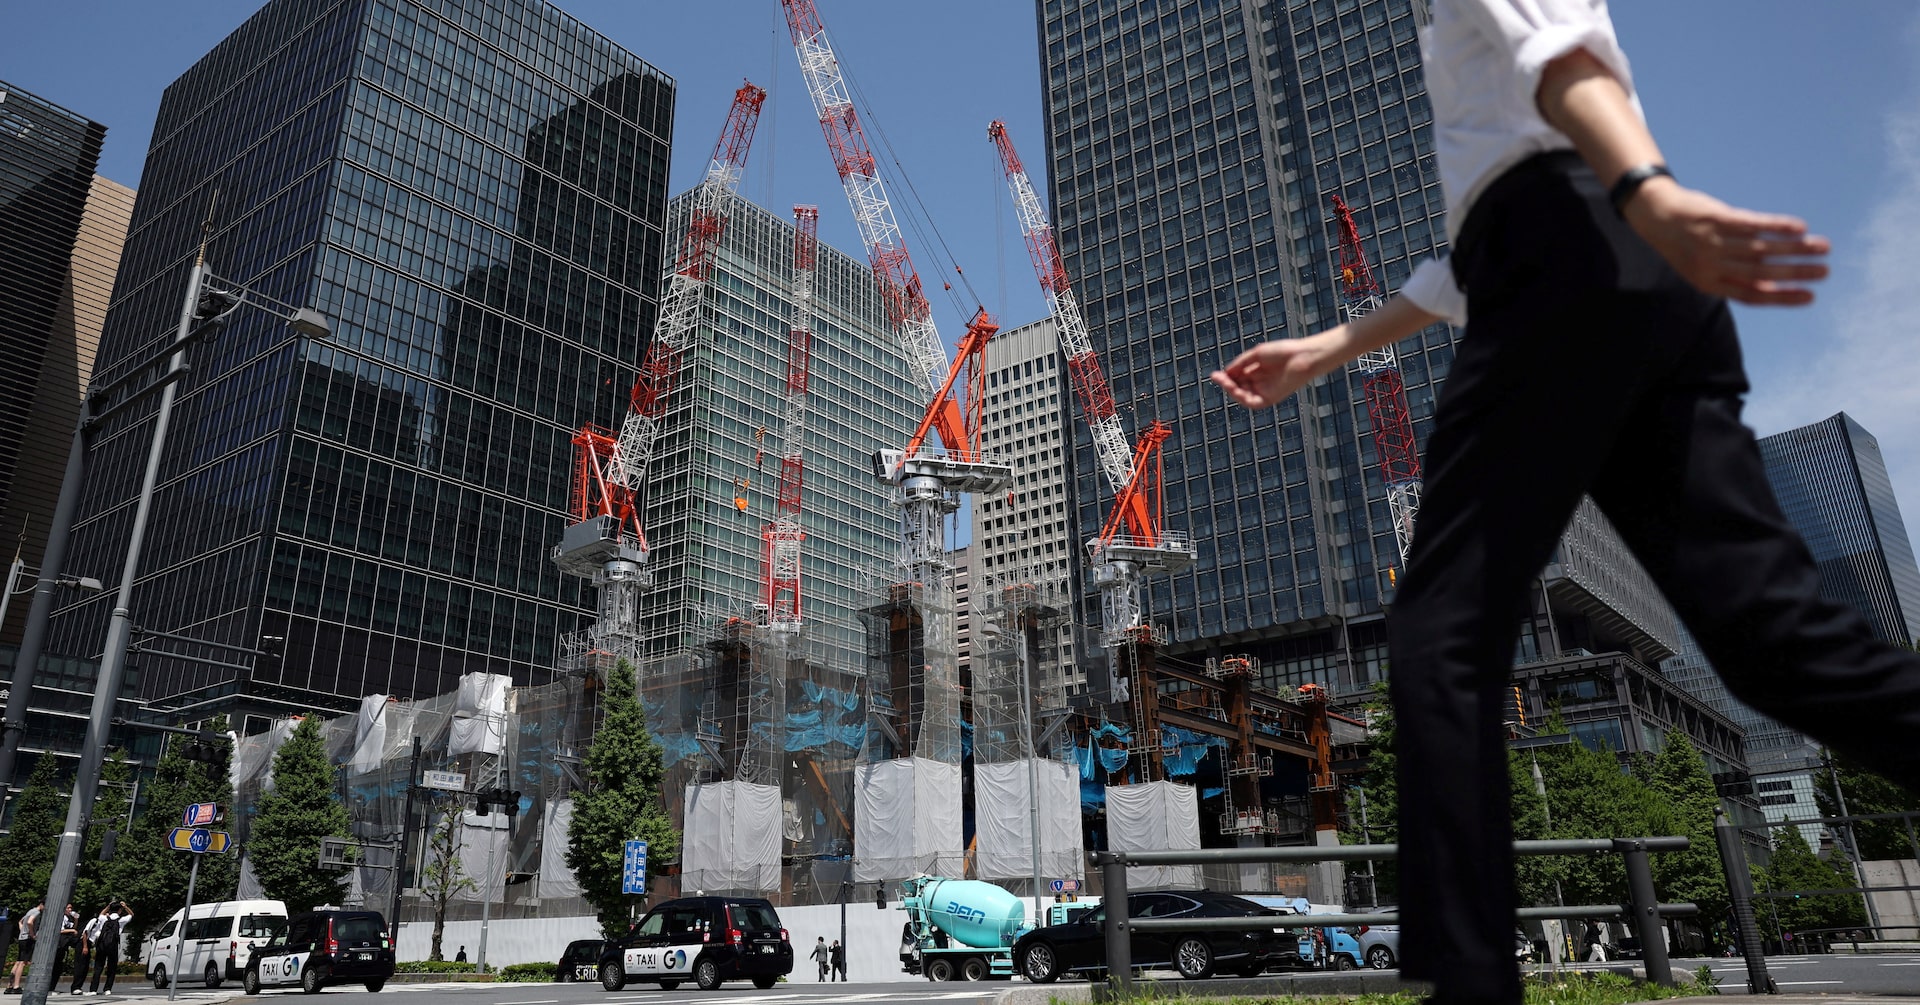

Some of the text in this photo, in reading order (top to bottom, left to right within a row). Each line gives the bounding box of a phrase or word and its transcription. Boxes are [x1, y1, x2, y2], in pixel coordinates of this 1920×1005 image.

[262, 956, 299, 976] TAXI GO
[636, 949, 687, 970] TAXI GO
